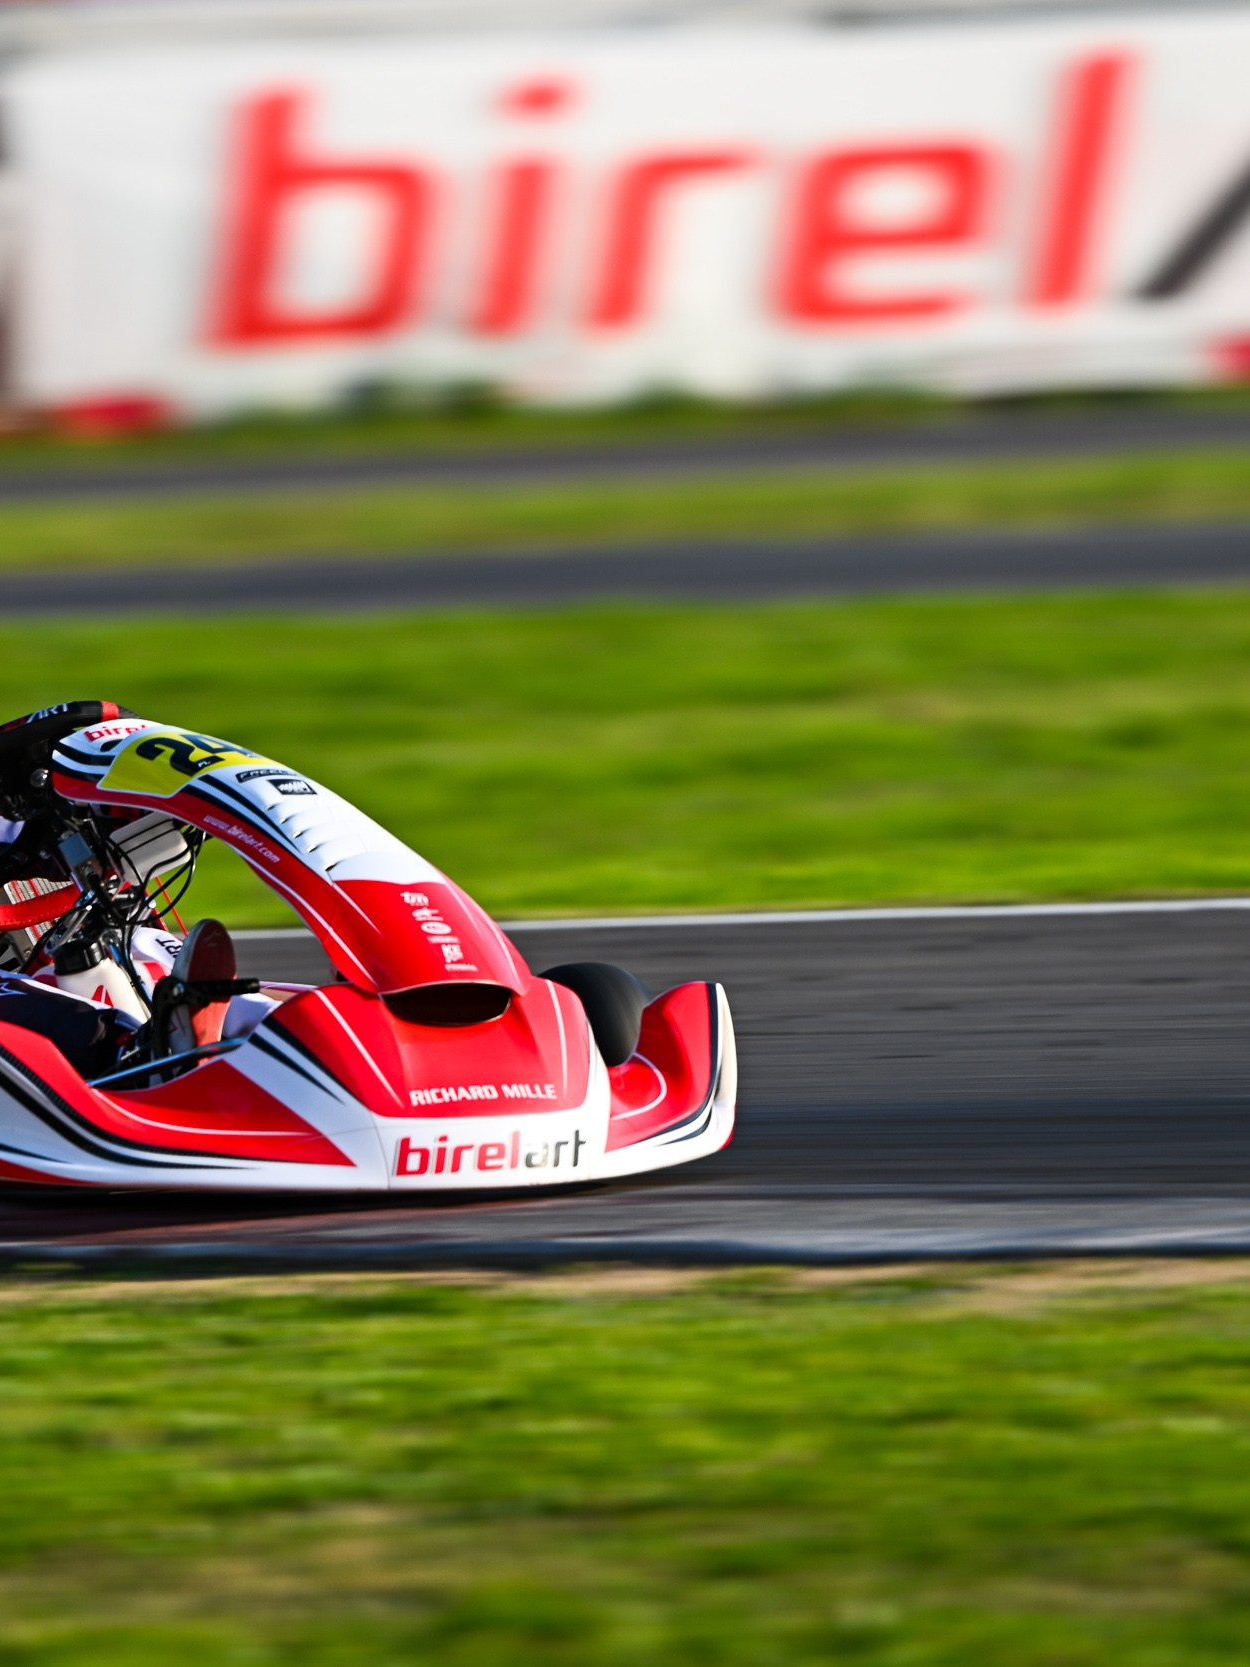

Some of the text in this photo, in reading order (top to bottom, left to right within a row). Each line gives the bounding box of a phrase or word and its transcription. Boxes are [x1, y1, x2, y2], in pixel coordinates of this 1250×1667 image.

[194, 45, 1250, 352] birel
[409, 1083, 557, 1106] RICHARD MILLE
[392, 1129, 586, 1177] birelart
